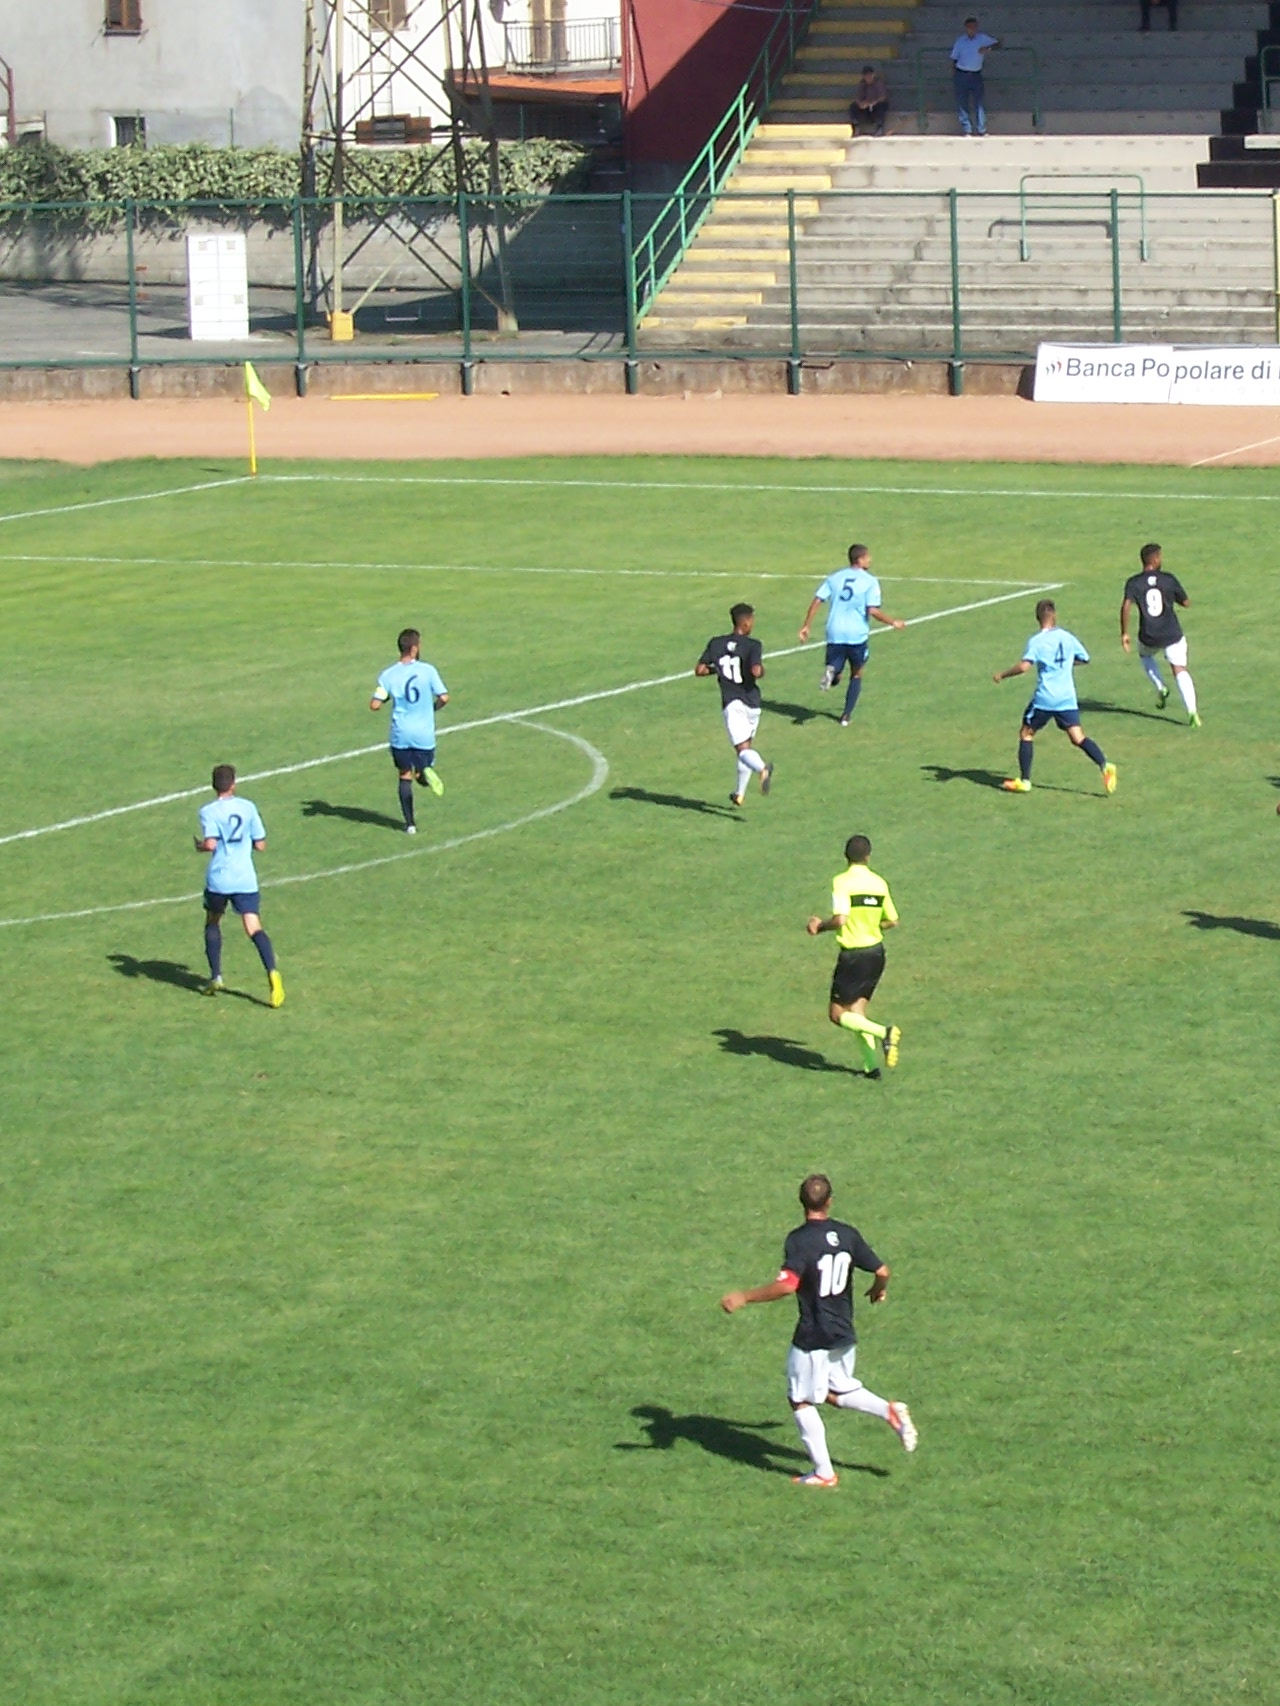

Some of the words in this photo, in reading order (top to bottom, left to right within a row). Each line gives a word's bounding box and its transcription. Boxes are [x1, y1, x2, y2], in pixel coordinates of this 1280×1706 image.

[1066, 358, 1135, 377] Banca
[1251, 360, 1271, 379] di
[840, 577, 856, 602] 5
[1146, 588, 1163, 617] 9
[719, 654, 743, 684] 11
[1054, 641, 1066, 669] 4
[405, 674, 420, 704] 6
[227, 814, 243, 843] 2
[817, 1251, 852, 1298] 10
